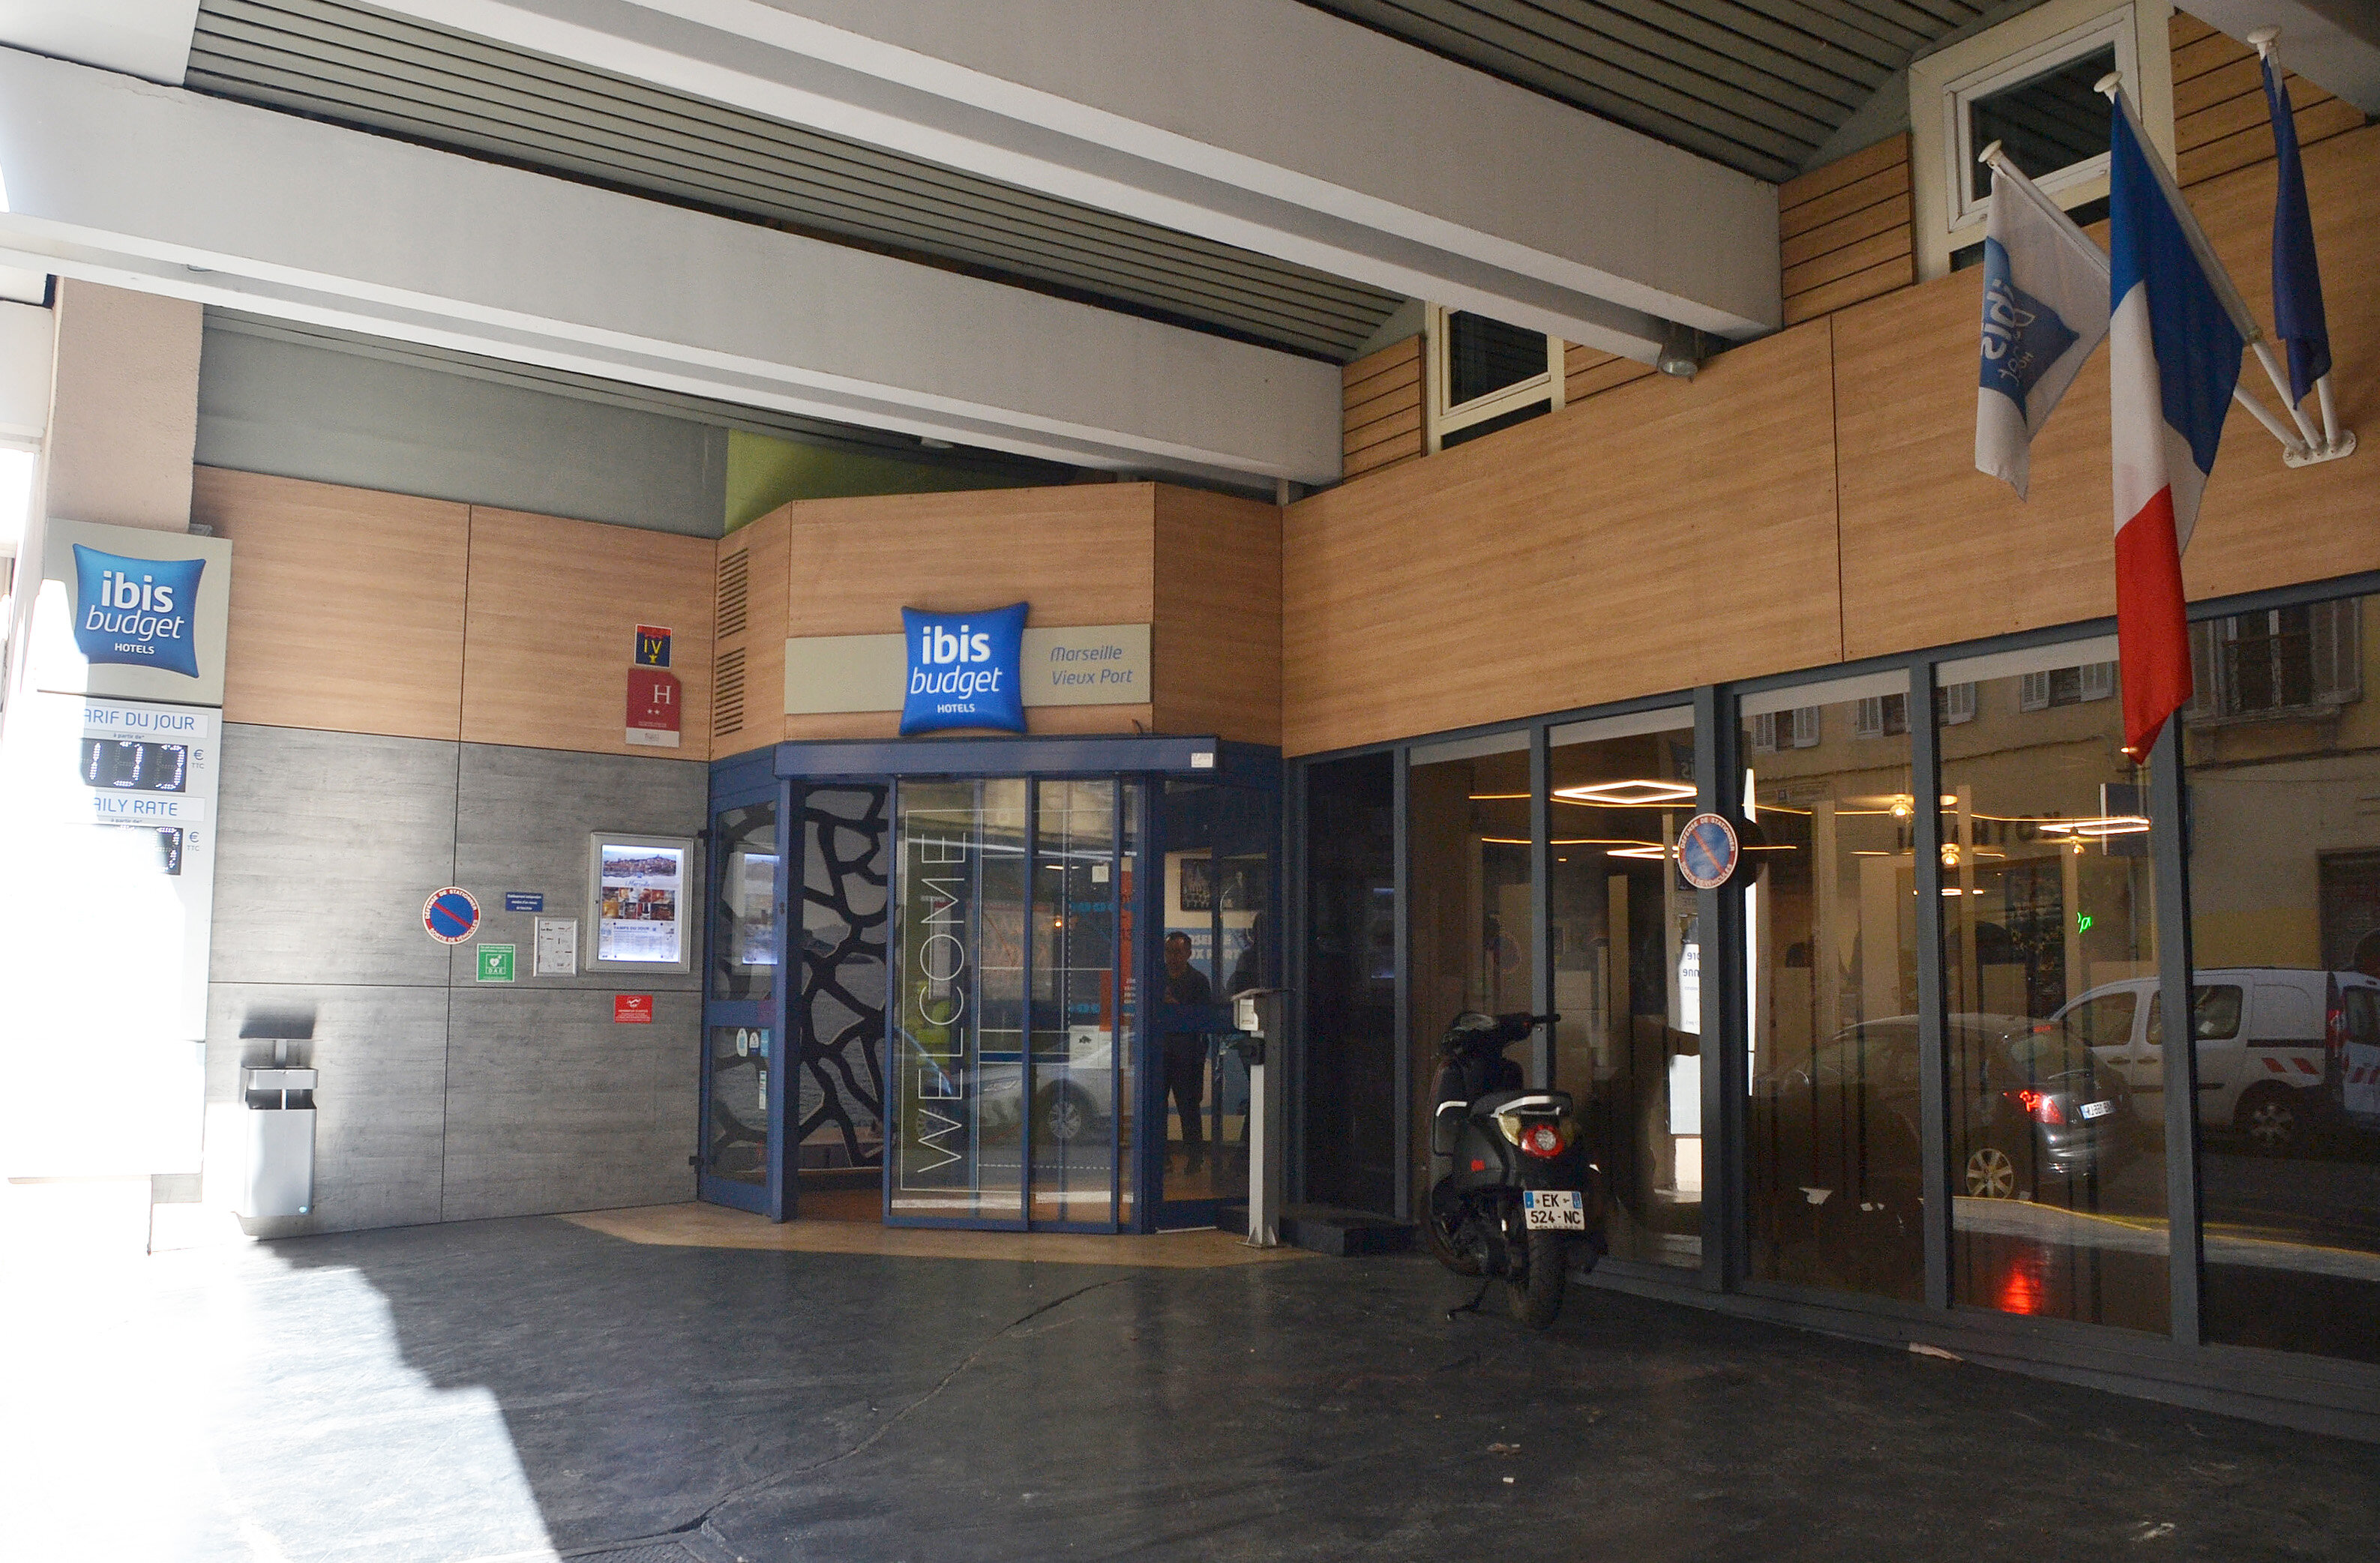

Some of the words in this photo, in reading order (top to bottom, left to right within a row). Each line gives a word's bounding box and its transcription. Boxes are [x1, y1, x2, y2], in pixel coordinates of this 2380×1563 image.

[101, 570, 174, 613] ibis
[85, 604, 184, 642] budget
[114, 642, 154, 654] HOTELS
[643, 639, 663, 654] IV
[922, 624, 991, 665] ibis
[1050, 645, 1123, 661] Marseille
[910, 665, 1003, 699] budget
[1052, 669, 1095, 685] Vieux
[1100, 668, 1134, 684] Port
[652, 684, 672, 705] H
[937, 703, 976, 714] HOTELS
[84, 708, 120, 725] ARIF
[125, 712, 148, 727] DU
[153, 714, 195, 731] JOUR
[193, 749, 204, 761] €
[94, 797, 128, 813] AILY
[133, 799, 178, 816] RATE
[189, 831, 199, 843] €
[917, 832, 967, 1174] WELCOME
